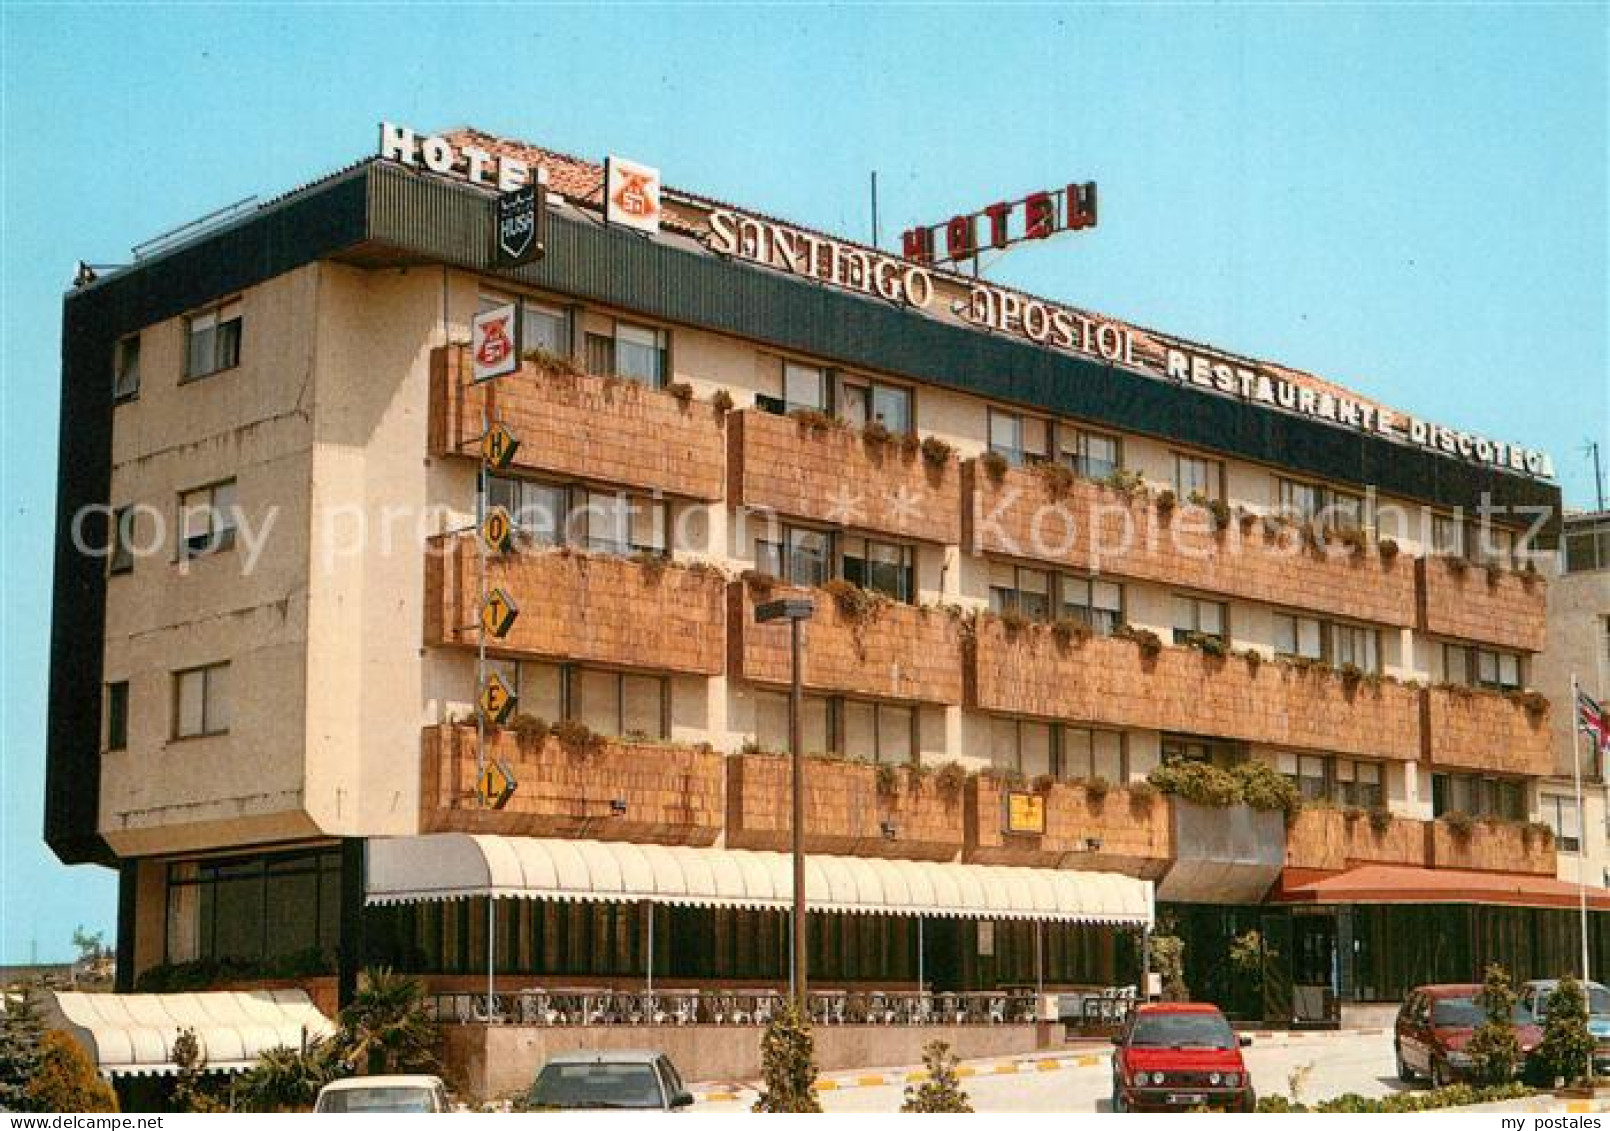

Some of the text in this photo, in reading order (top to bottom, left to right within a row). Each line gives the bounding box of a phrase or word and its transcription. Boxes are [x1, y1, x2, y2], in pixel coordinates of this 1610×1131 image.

[903, 181, 1097, 266] HOTEL
[1167, 348, 1395, 436] RESTAURANTE
[1410, 416, 1556, 478] DISCOTECA
